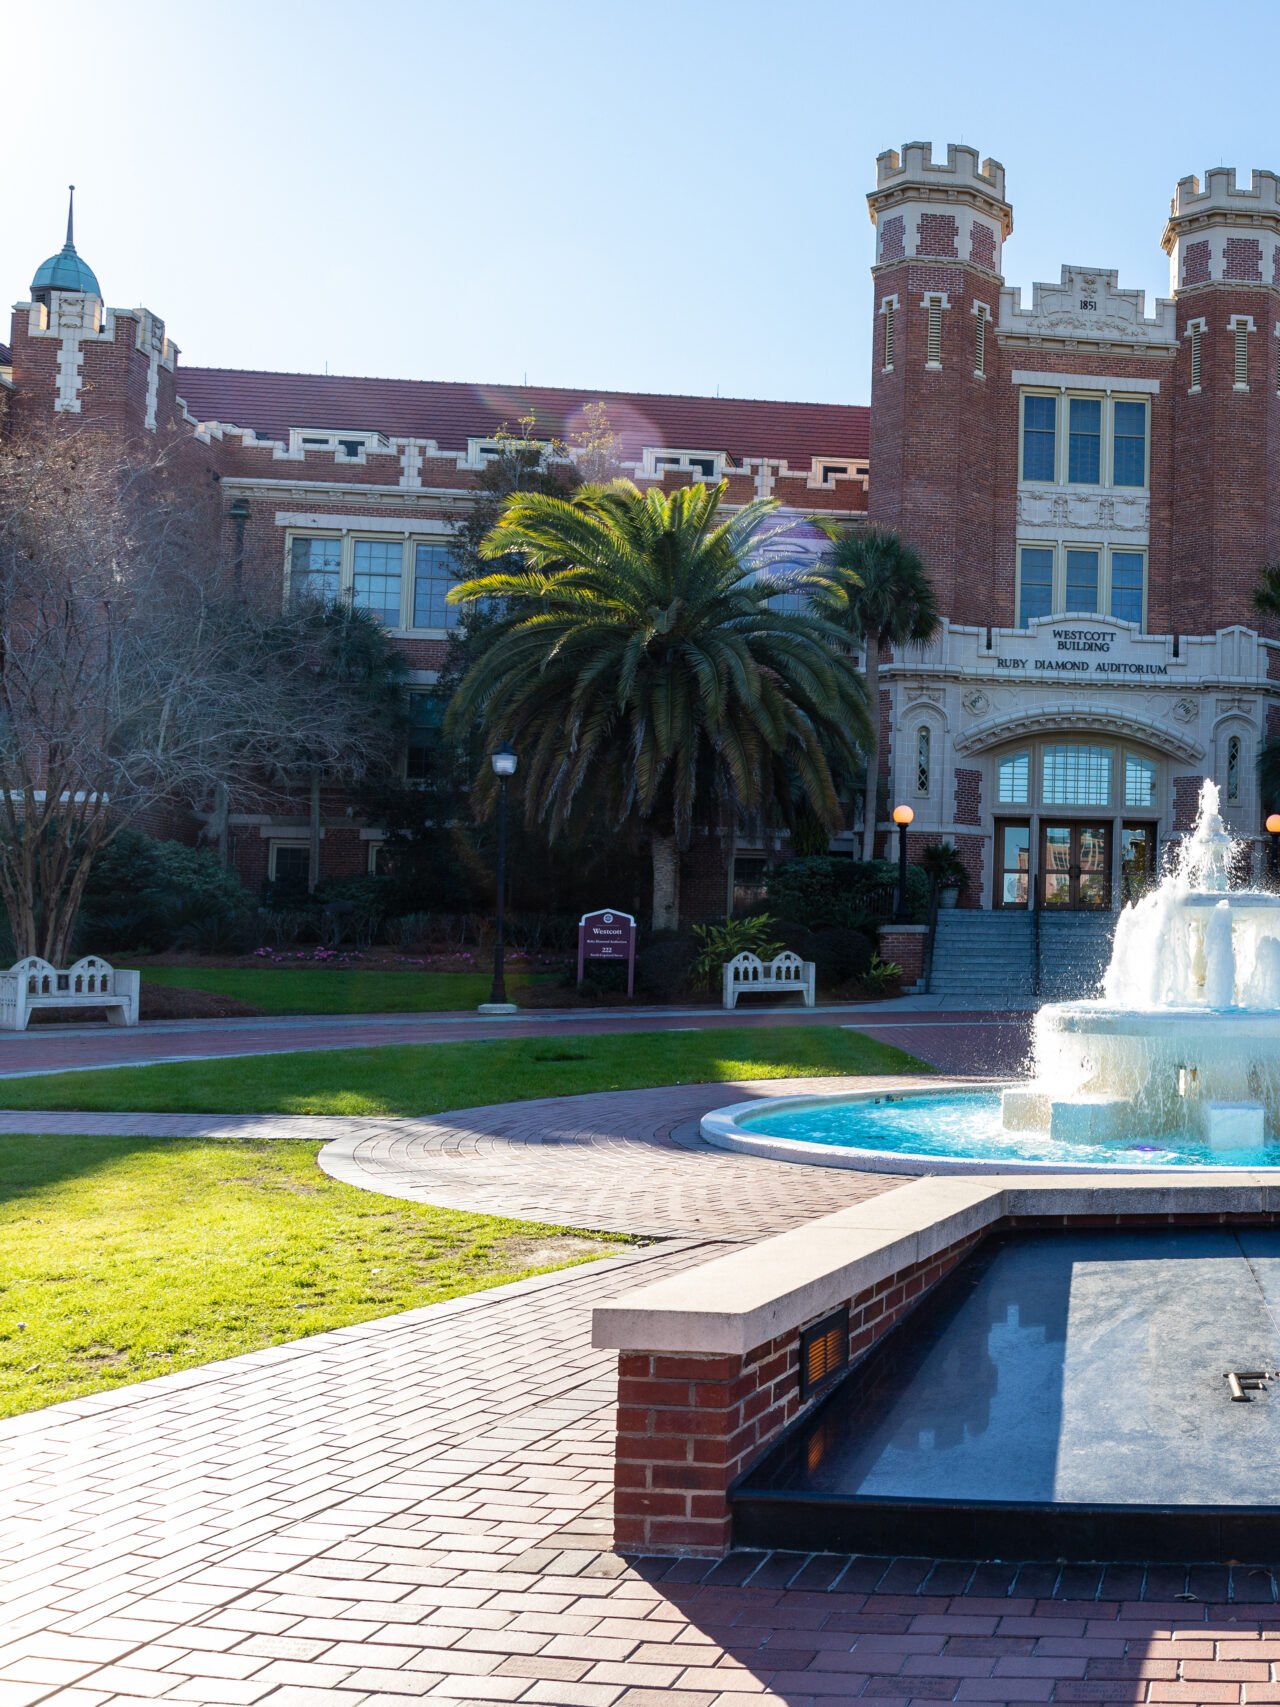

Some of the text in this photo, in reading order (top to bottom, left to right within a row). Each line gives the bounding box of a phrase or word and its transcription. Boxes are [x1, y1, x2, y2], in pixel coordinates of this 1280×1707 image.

[1080, 300, 1097, 311] 1851
[1053, 629, 1116, 642] WESTCOTT
[1057, 641, 1110, 652] BUILDING
[997, 658, 1167, 674] RUBY DIAMOND AUDITORIUM
